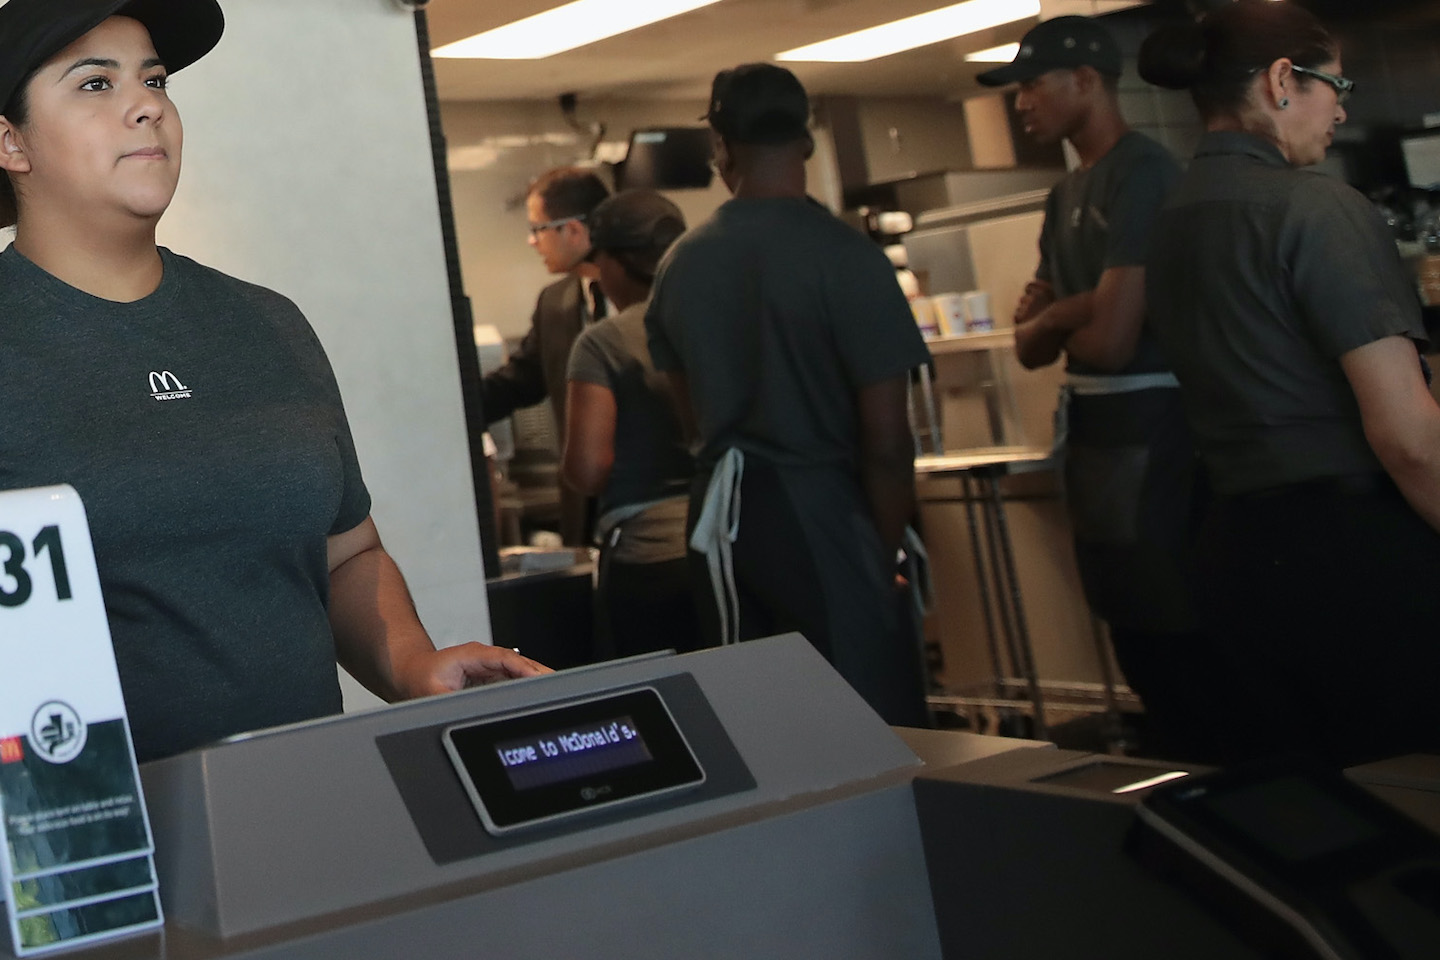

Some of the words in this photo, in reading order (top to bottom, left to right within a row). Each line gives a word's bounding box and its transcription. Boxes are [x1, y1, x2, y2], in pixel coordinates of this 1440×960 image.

[155, 392, 192, 401] WELCOME
[539, 739, 559, 758] to
[558, 721, 637, 754] McDonald's.
